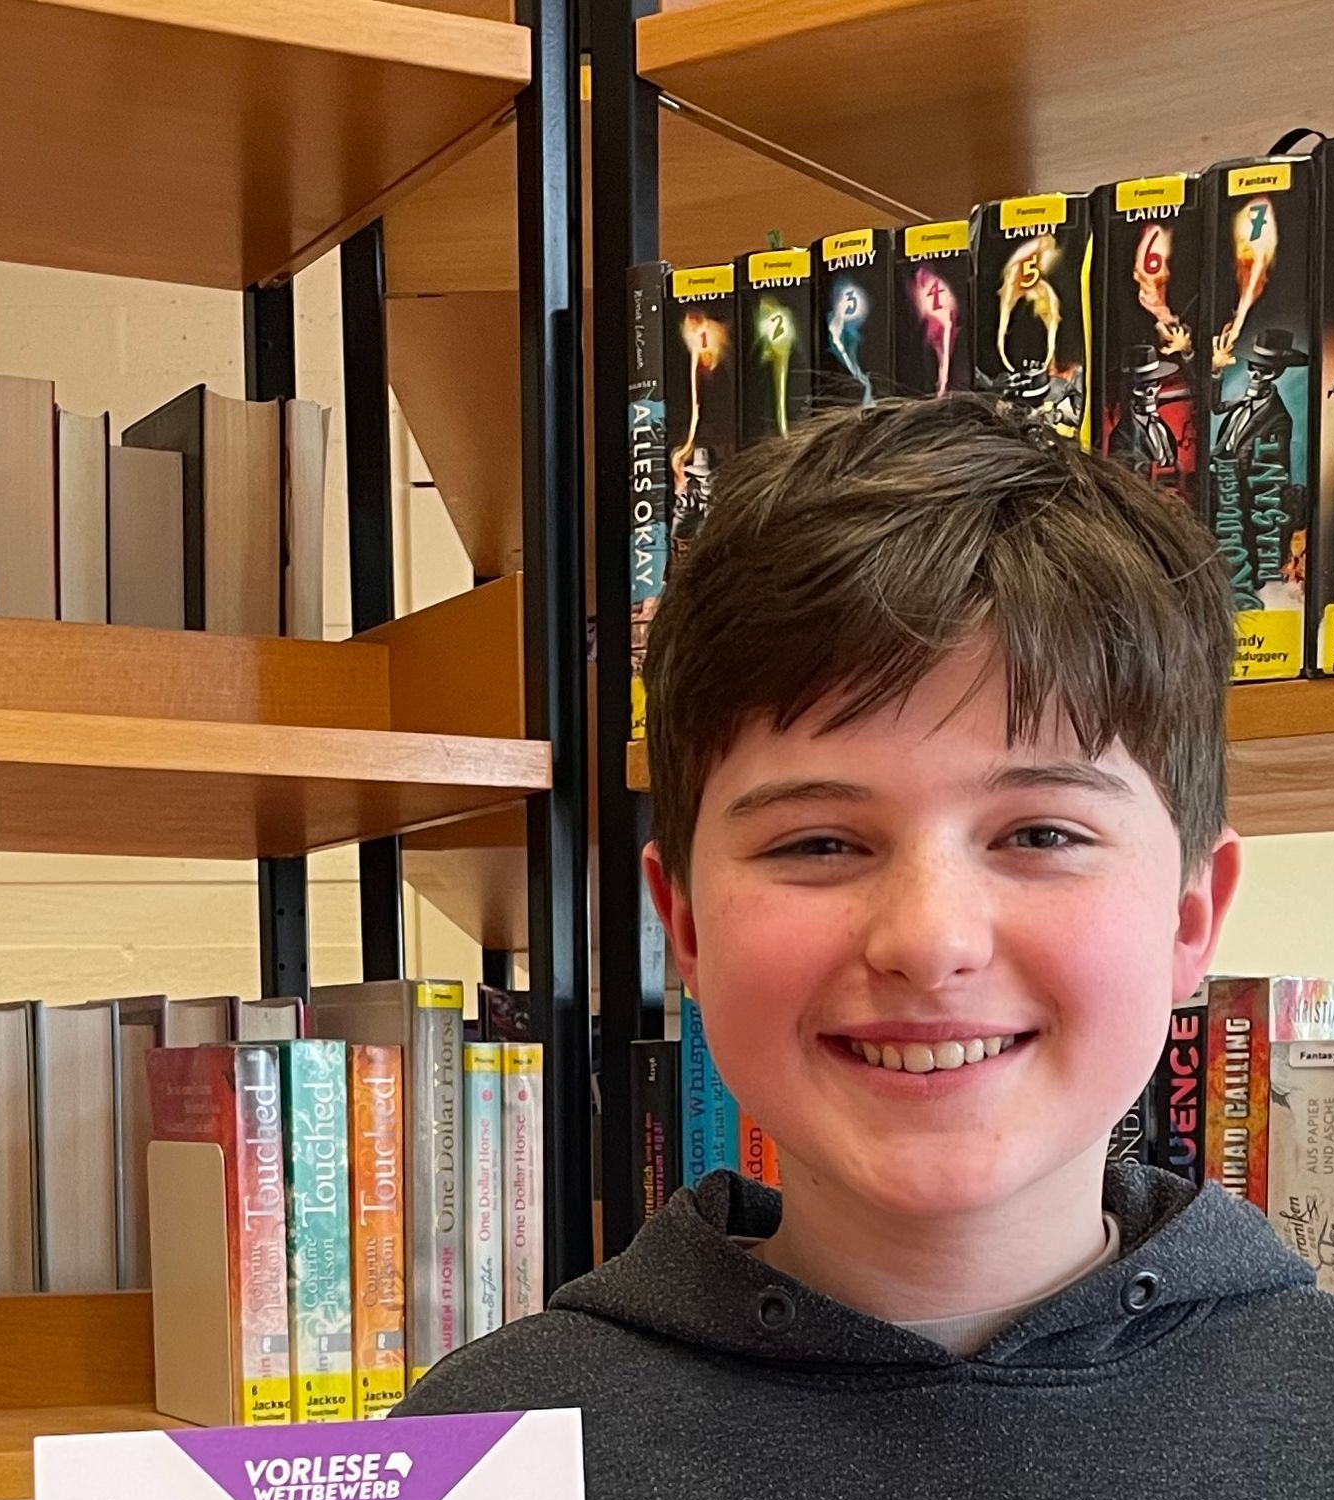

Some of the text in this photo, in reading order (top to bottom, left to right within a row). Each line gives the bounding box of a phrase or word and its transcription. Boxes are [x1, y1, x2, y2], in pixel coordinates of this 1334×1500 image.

[630, 404, 653, 494] ALLES
[1224, 1017, 1250, 1118] CALLING
[244, 1081, 277, 1231] Touched
[436, 1016, 454, 1233] One Dollar Horse
[244, 1453, 381, 1485] VORLESE
